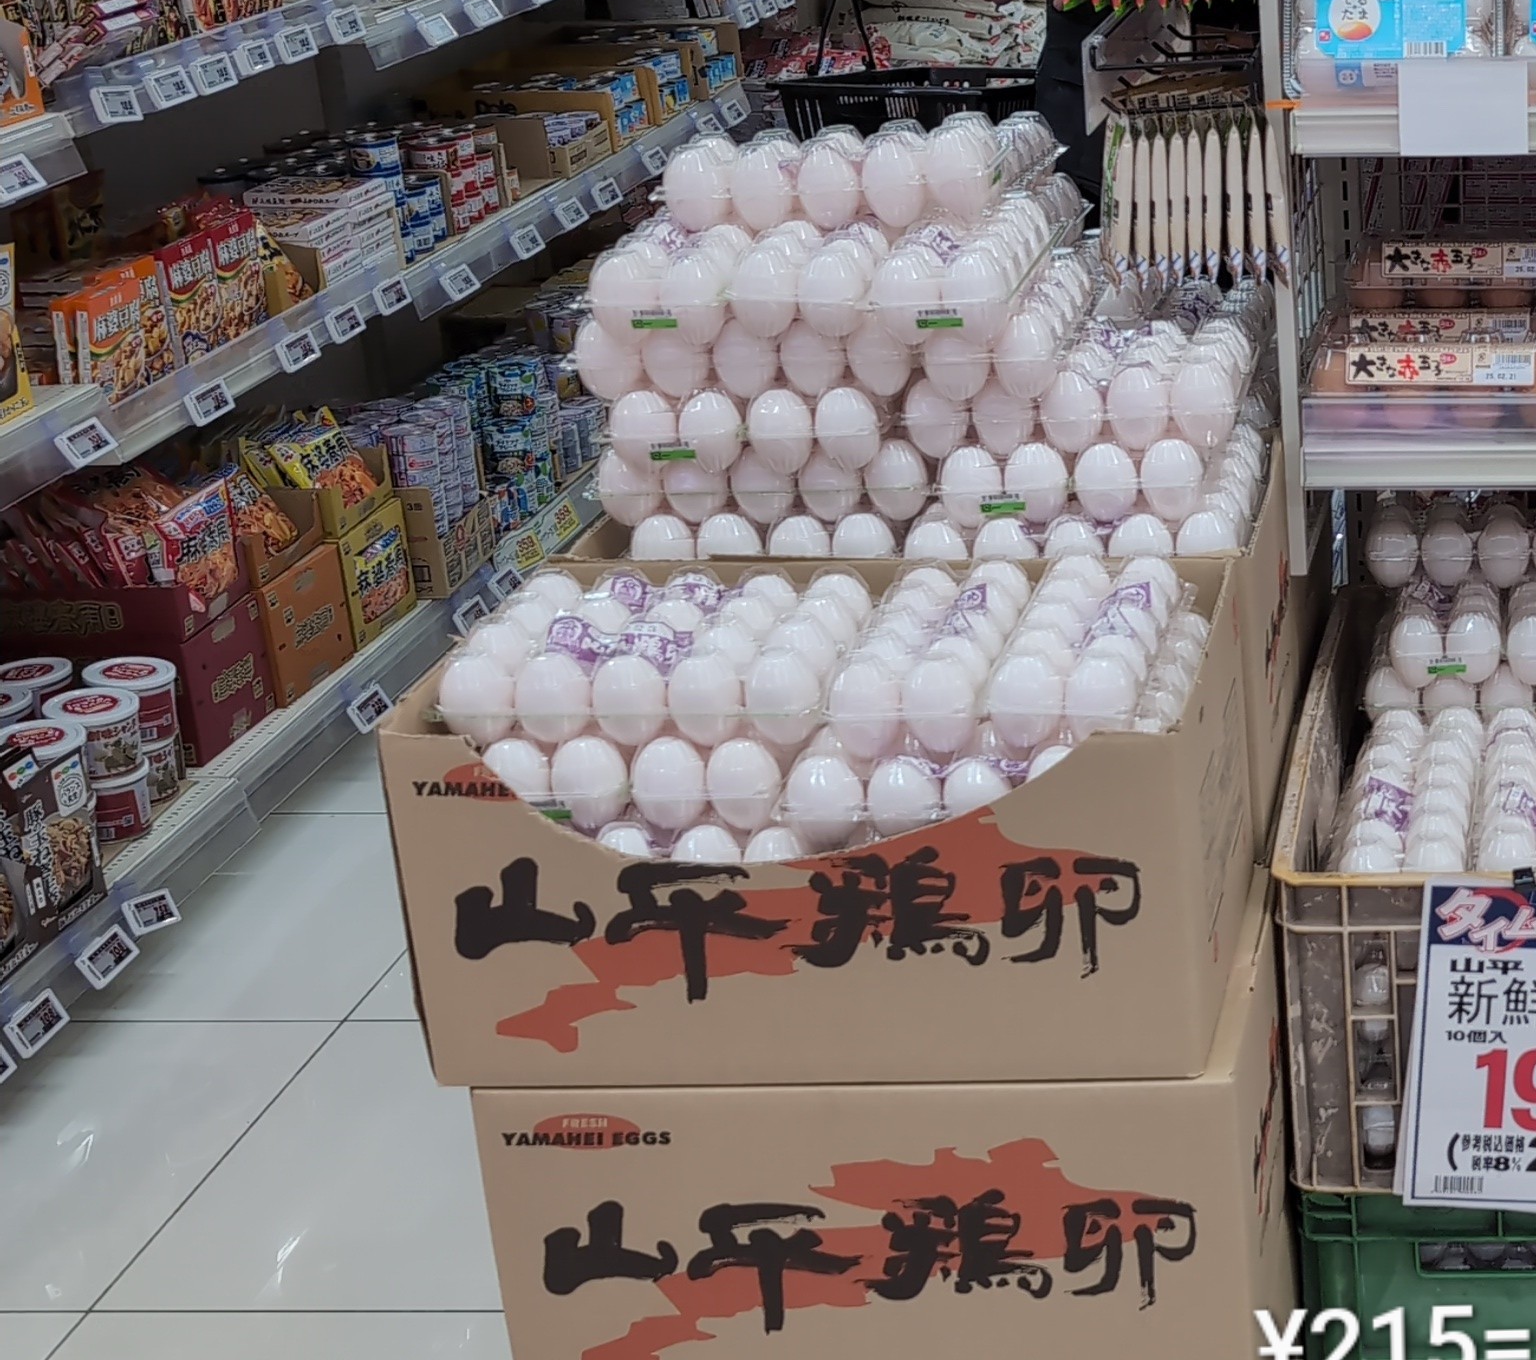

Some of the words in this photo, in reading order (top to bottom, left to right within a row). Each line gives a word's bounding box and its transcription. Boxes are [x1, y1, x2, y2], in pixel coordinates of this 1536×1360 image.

[1385, 245, 1476, 274] 大きな赤玉子
[1350, 353, 1445, 382] 大きな赤玉子
[1449, 957, 1525, 975] 山平
[1447, 1030, 1508, 1045] 10個入
[561, 1115, 609, 1129] FRESH
[501, 1131, 605, 1147] YAMAHEI
[611, 1129, 672, 1147] EGGS
